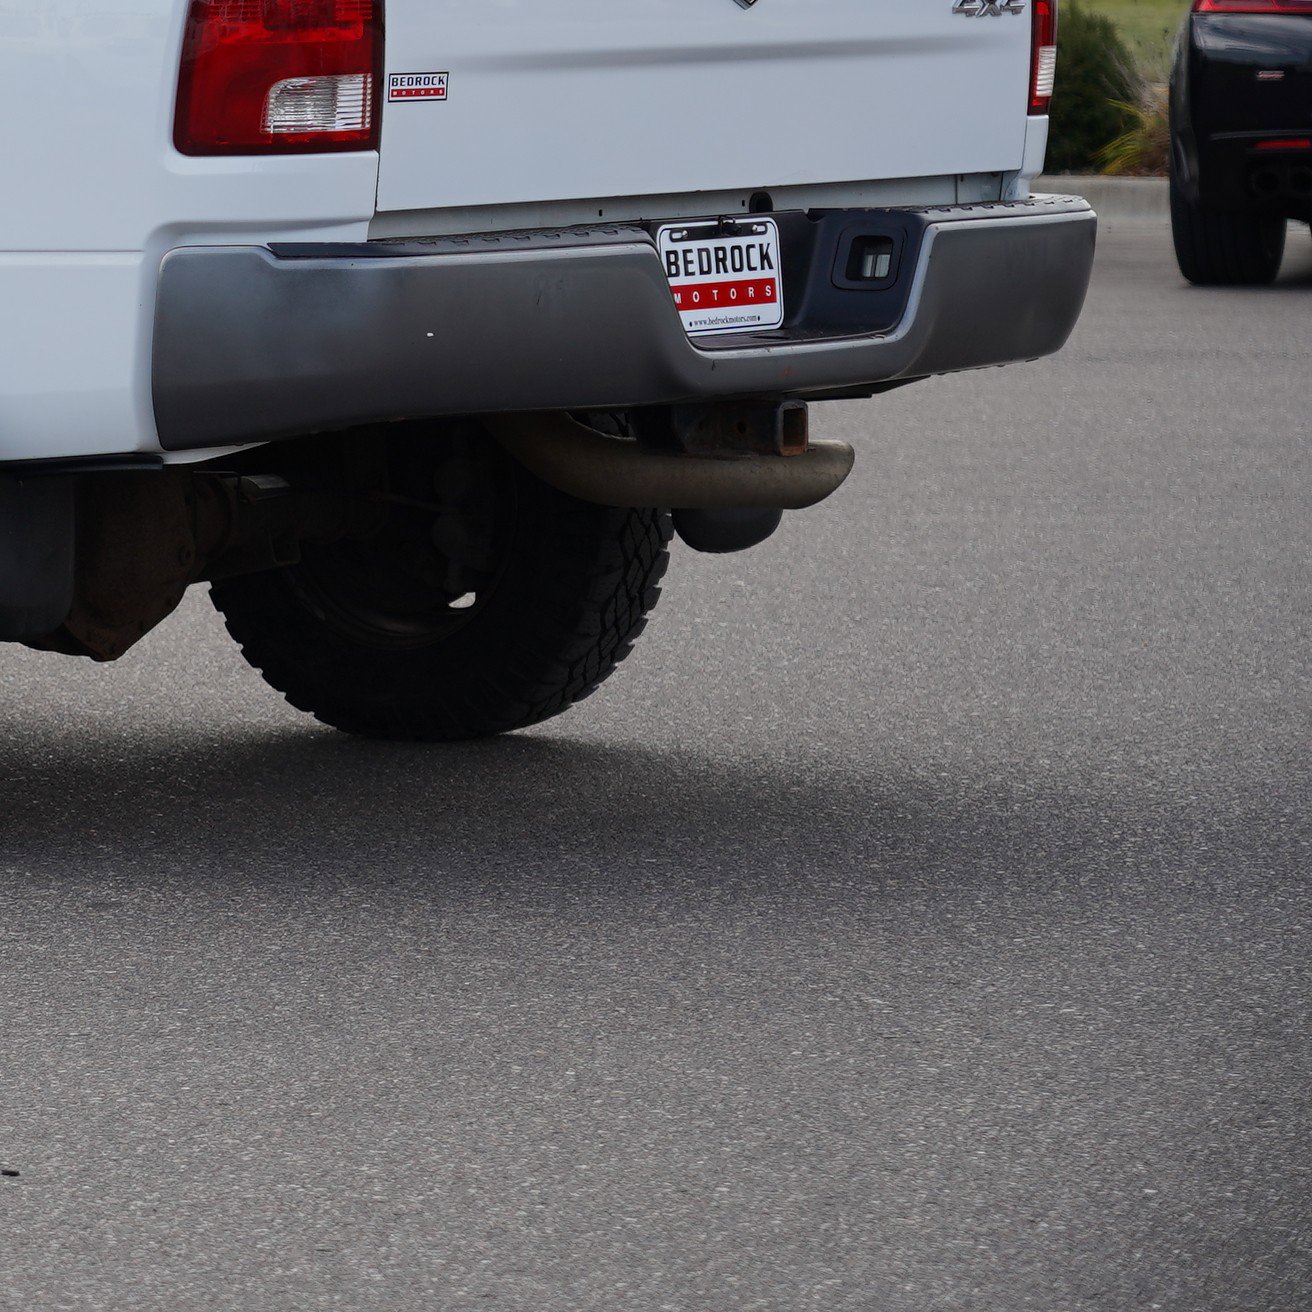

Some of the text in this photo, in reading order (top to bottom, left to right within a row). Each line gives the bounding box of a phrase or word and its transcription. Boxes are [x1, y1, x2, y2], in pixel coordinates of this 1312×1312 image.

[391, 75, 445, 87] BEDROCK
[665, 242, 775, 278] BEDROCK
[673, 285, 772, 304] MOTORS
